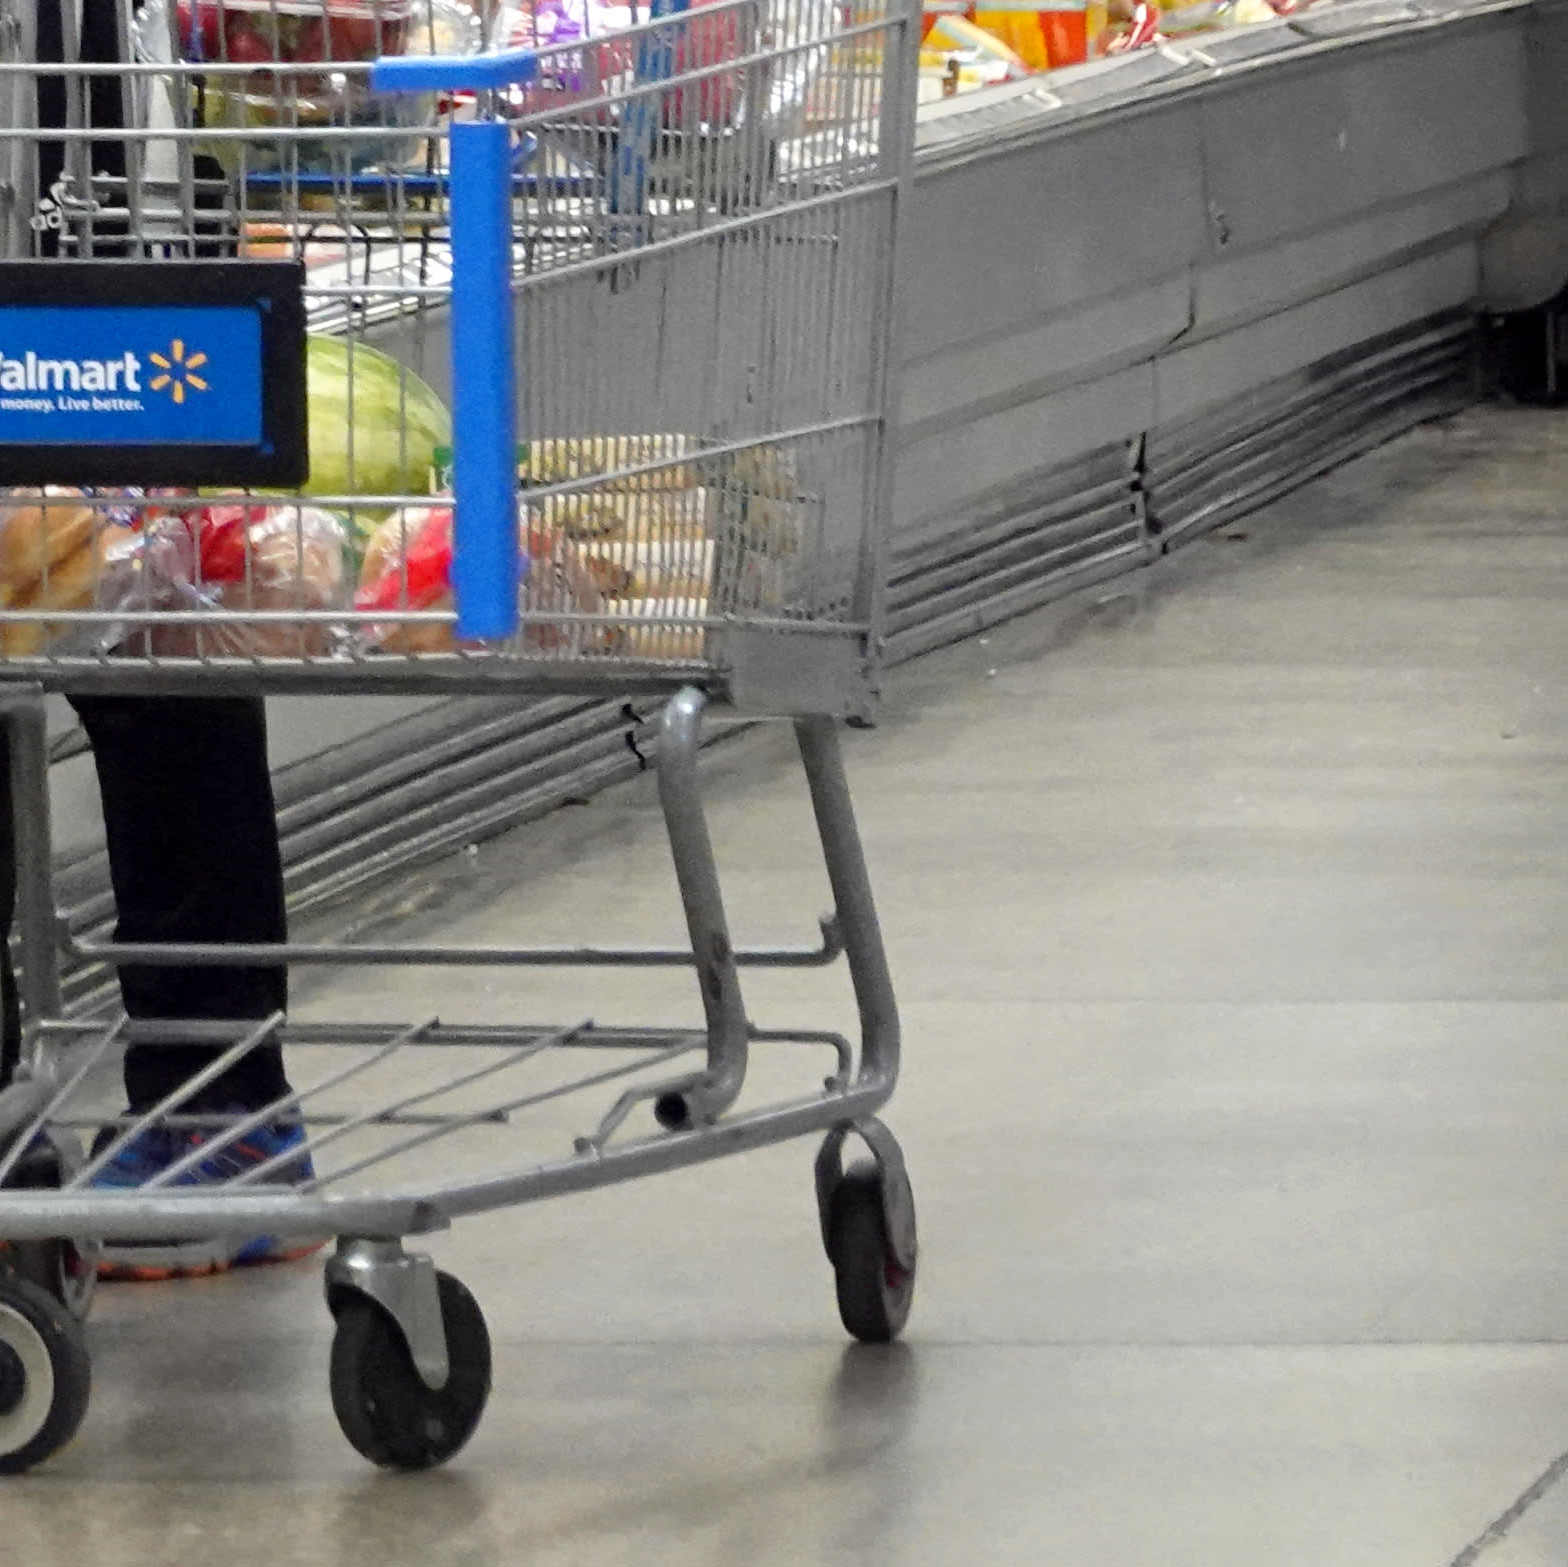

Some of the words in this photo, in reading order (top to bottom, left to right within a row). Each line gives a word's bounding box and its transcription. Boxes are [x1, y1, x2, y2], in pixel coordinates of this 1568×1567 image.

[0, 398, 56, 414] money.
[58, 396, 90, 412] Live
[92, 395, 145, 412] better.
